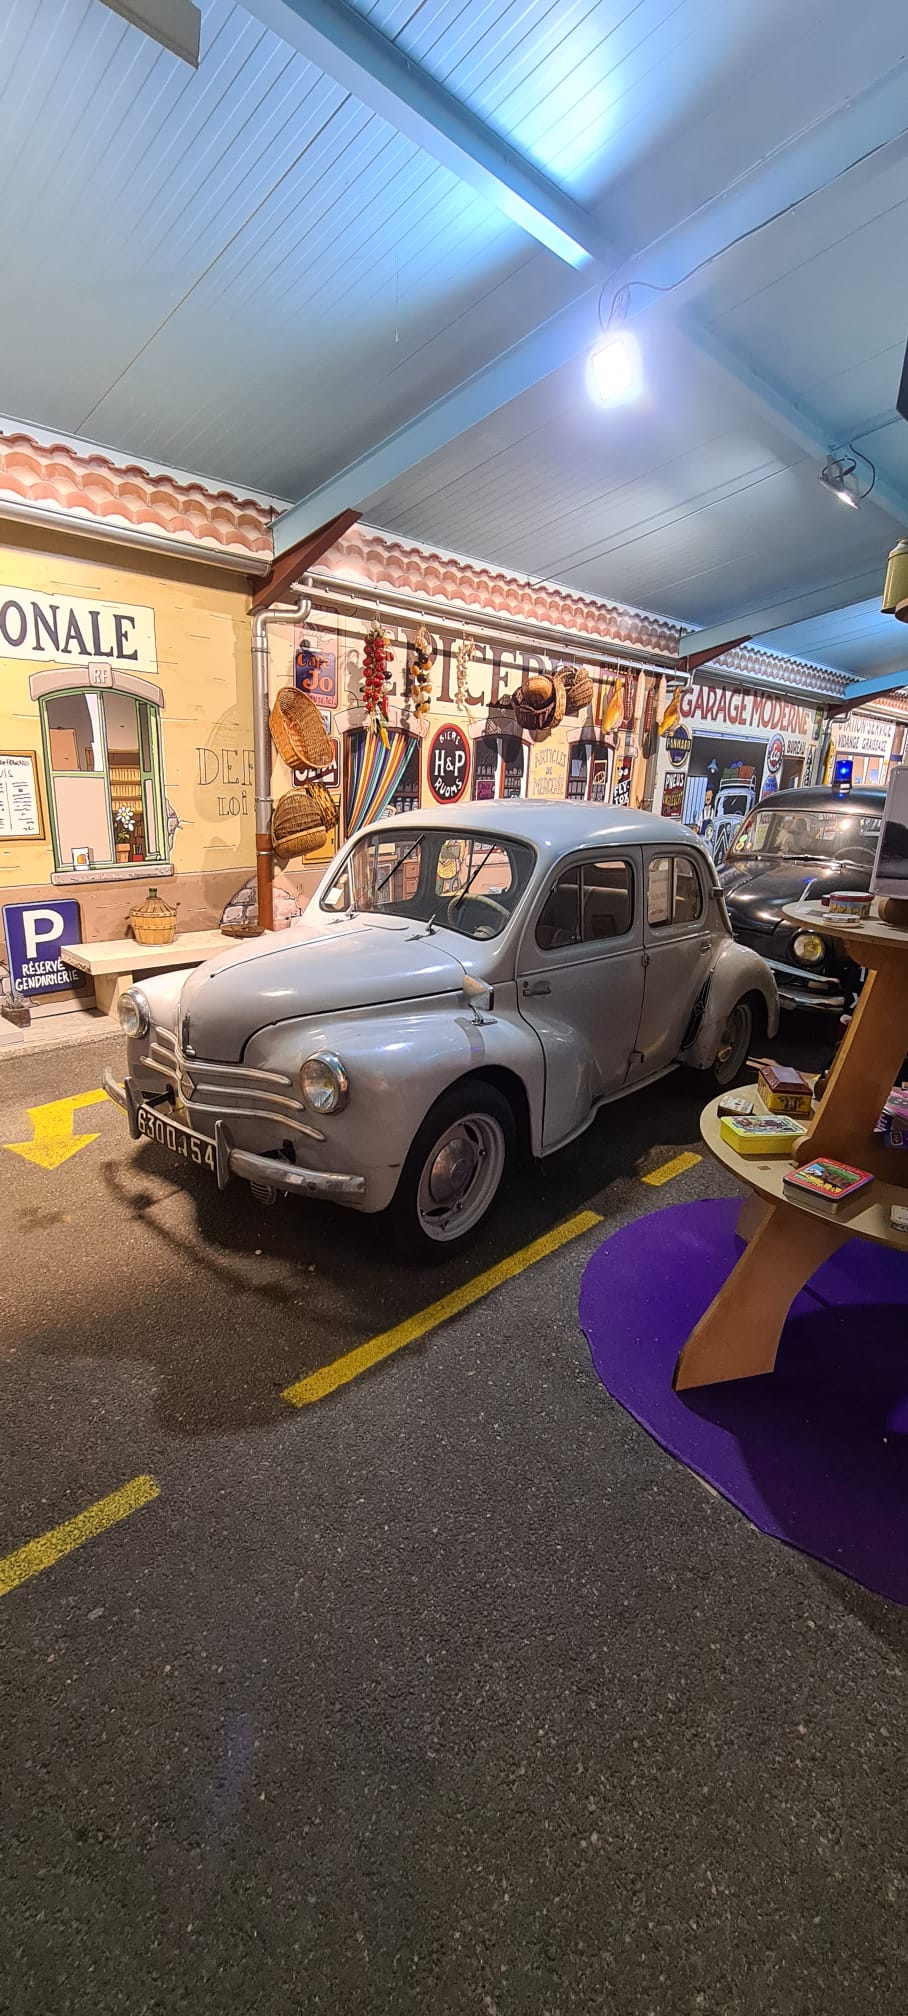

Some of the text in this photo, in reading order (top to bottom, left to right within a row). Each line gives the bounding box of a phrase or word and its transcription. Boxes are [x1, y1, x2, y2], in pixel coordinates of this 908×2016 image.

[0, 600, 138, 660] ONALE
[302, 669, 333, 692] Jo
[679, 686, 810, 736] GARAGE MODERNE
[433, 777, 463, 798] RUOMS
[664, 773, 685, 789] PNEUS
[22, 909, 64, 959] P
[15, 969, 80, 991] GENDARMERIE
